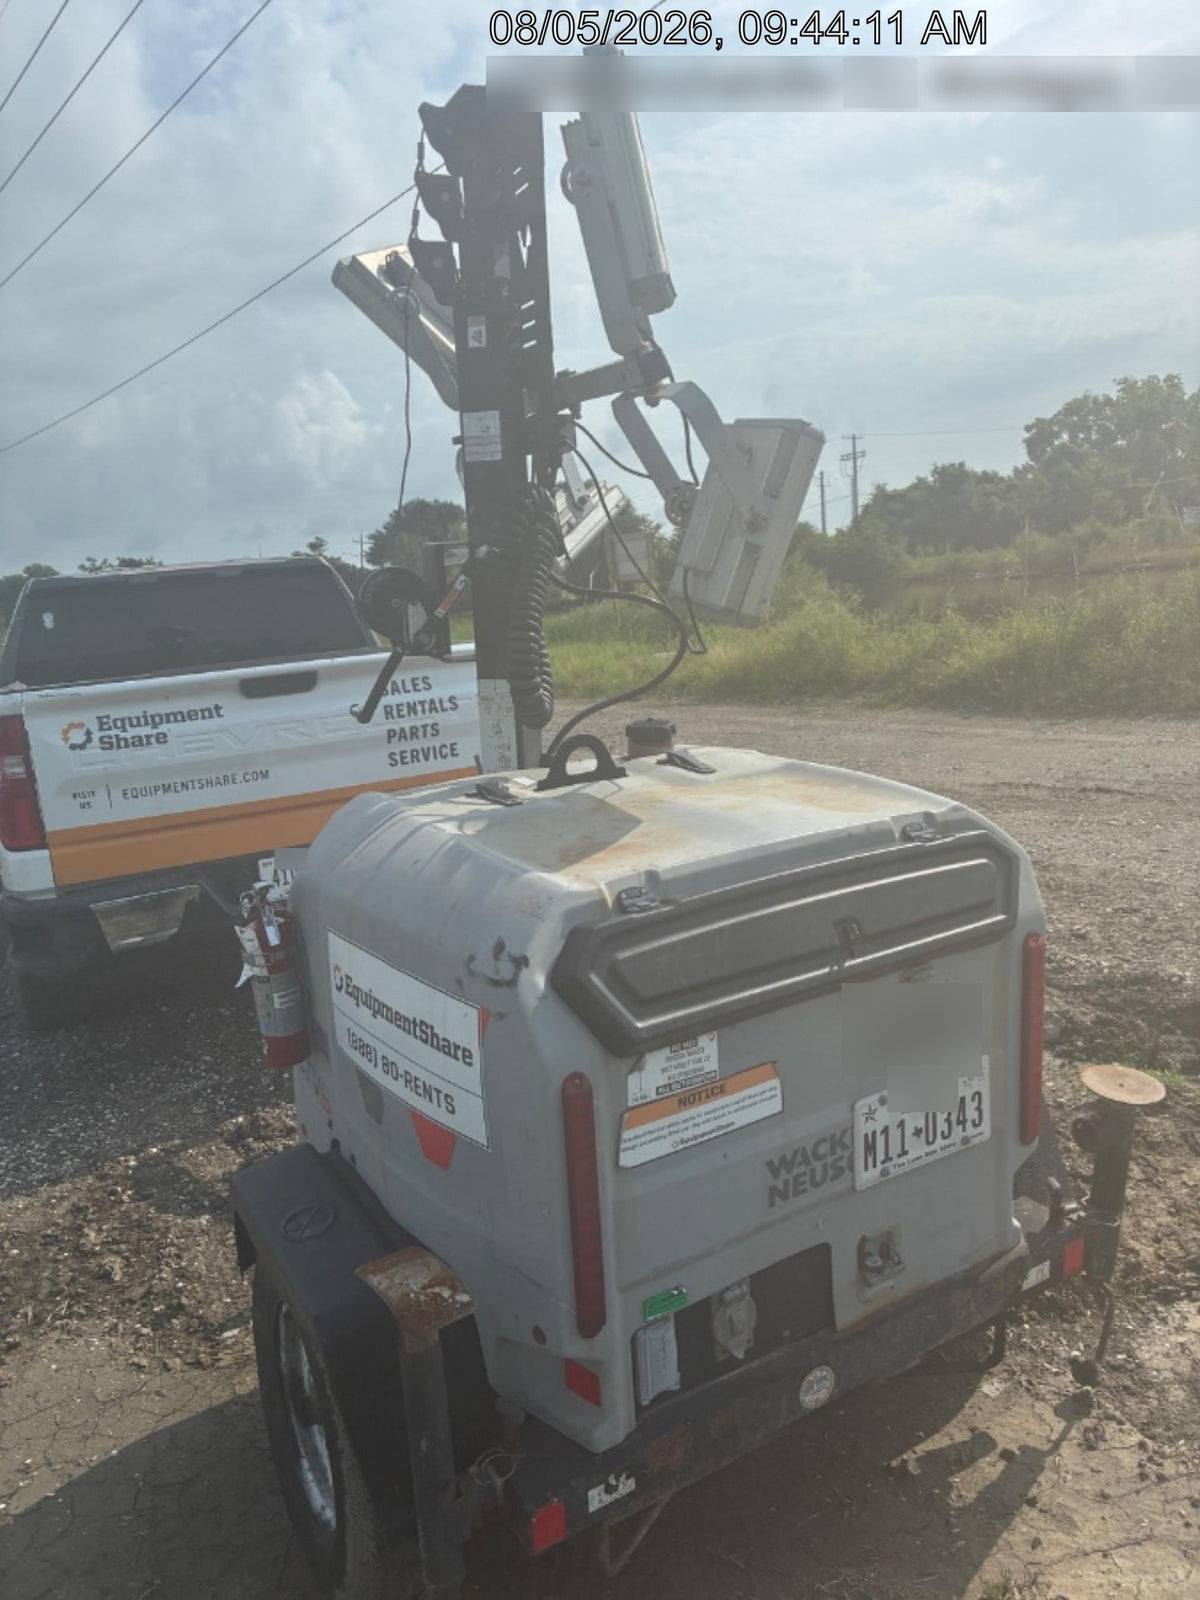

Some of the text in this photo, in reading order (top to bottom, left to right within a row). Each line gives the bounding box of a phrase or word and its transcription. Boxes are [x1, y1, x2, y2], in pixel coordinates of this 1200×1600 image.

[96, 703, 224, 733] Equipment
[383, 695, 459, 721] RENTALS
[98, 731, 169, 751] Share
[386, 722, 440, 745] PARTS
[388, 742, 460, 768] SERVICE
[71, 790, 96, 801] VISIT
[121, 769, 270, 801] EQUIPMENTSHARE.COM
[79, 801, 93, 810] US
[344, 974, 474, 1068] EquipmentShare
[347, 1027, 456, 1115] (888) 80-RENTS
[676, 1082, 727, 1109] NOTICE
[767, 1154, 854, 1209] NEUS
